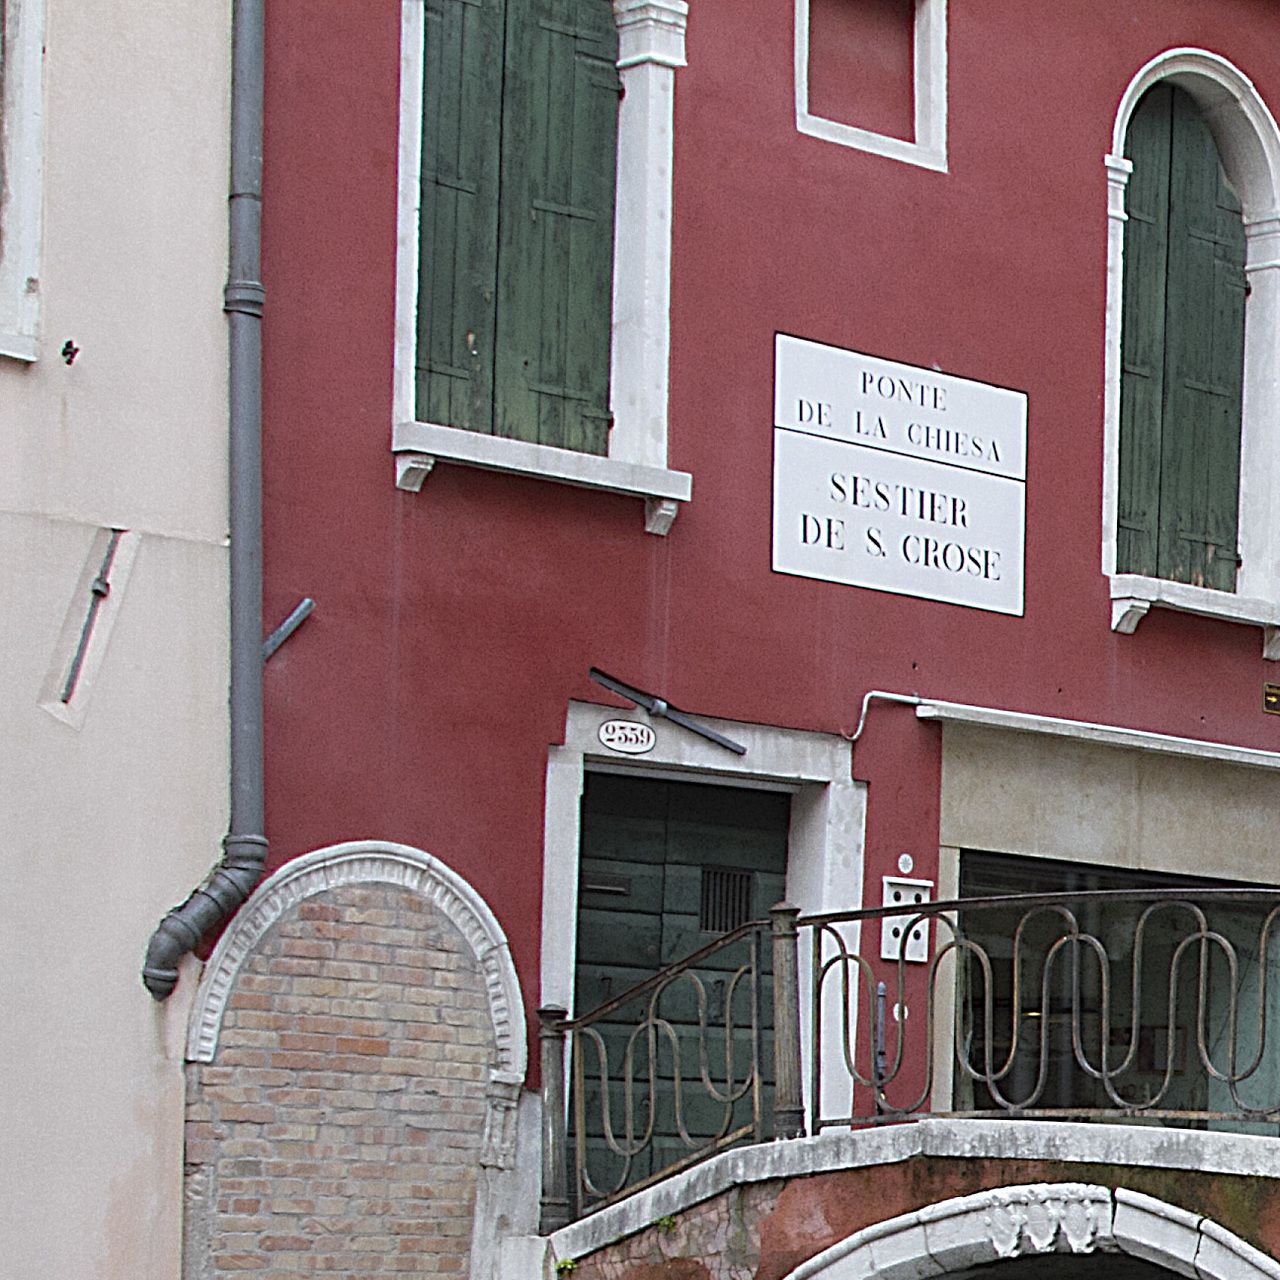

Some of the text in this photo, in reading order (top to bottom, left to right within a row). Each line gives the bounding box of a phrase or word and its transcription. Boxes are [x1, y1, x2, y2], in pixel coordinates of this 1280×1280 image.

[861, 370, 947, 412] PONTE
[798, 398, 1001, 463] DE LA CHIESA
[829, 471, 968, 529] SESTIER
[800, 512, 1002, 582] DE S. CROSE
